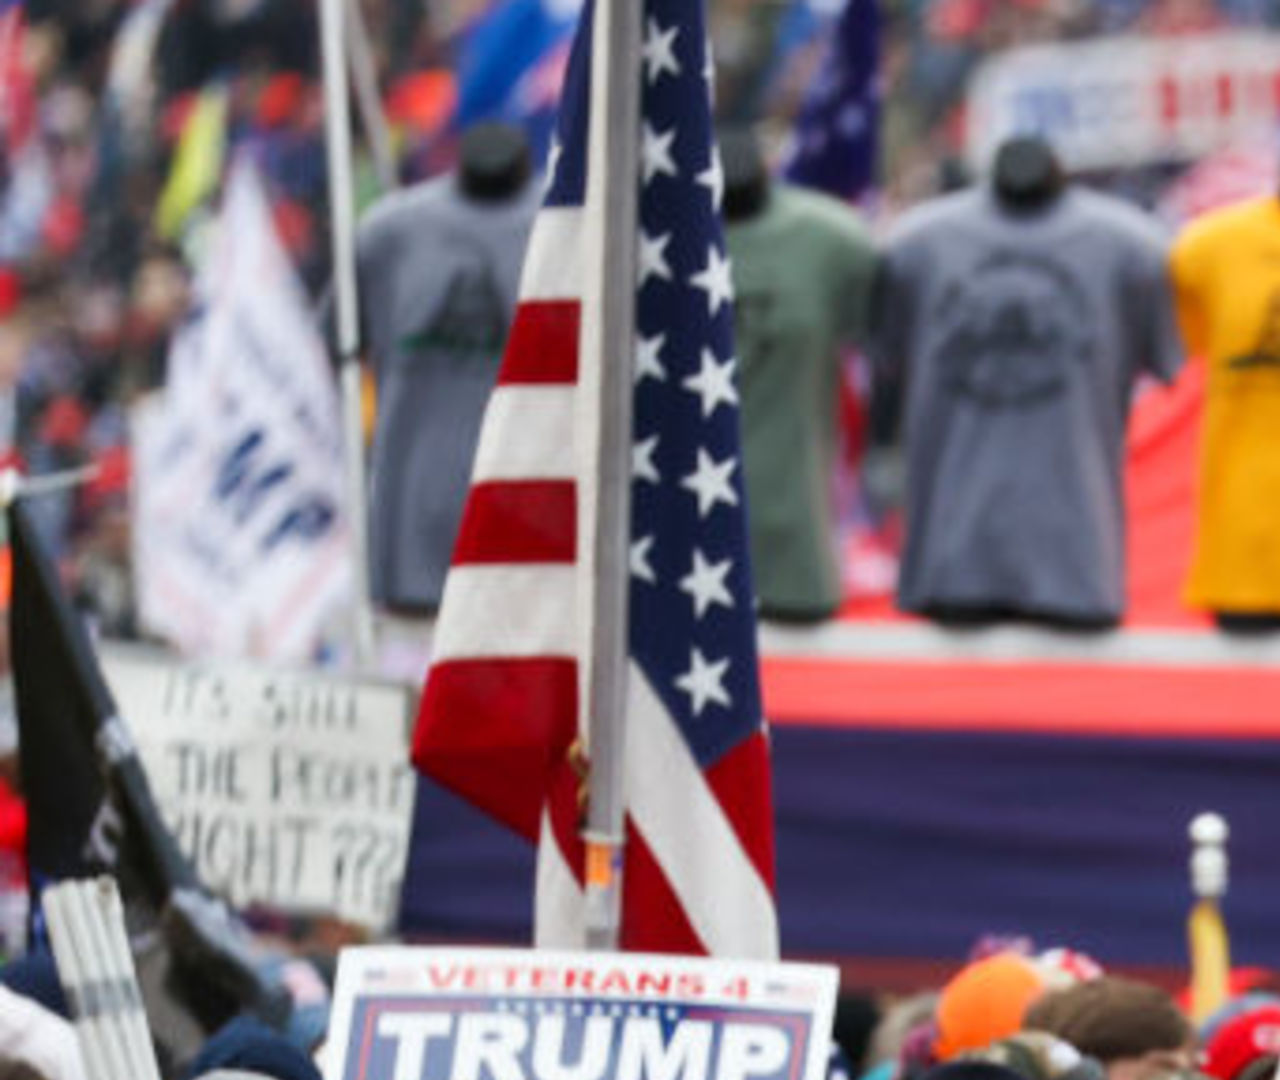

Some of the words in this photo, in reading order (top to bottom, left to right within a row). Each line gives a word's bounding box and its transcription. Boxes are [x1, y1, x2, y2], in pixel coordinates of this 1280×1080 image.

[168, 743, 246, 806] THE
[427, 965, 706, 998] VETERANS
[722, 974, 751, 1001] 4
